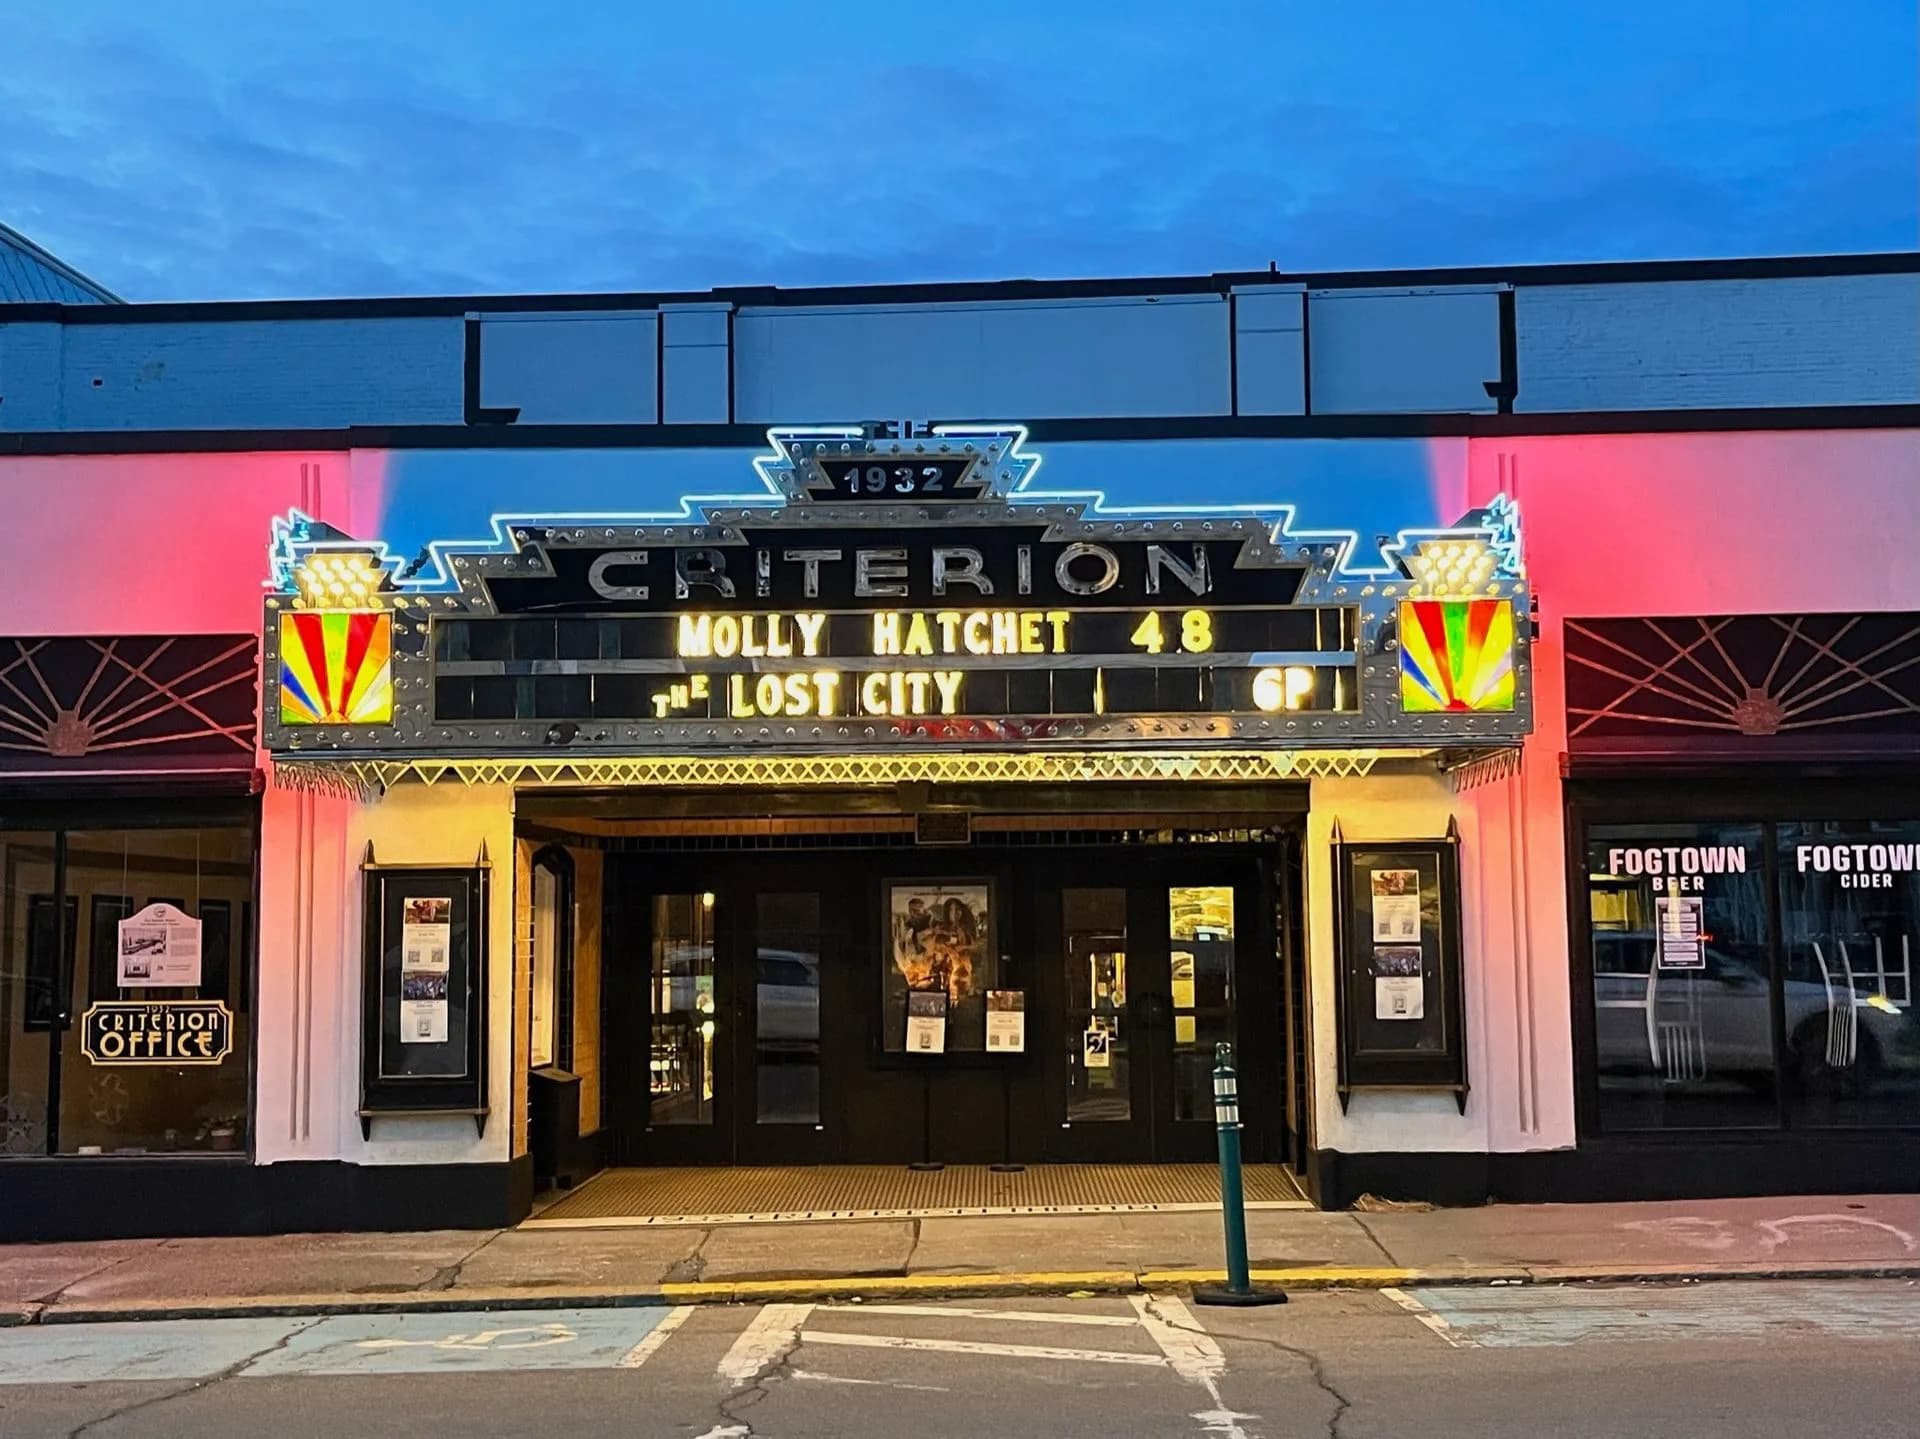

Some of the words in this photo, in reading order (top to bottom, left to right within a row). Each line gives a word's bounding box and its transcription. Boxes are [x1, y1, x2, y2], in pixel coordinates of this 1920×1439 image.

[843, 467, 943, 493] 1932
[588, 543, 1213, 599] CRITERION
[678, 613, 826, 657] MOLLY
[873, 611, 1071, 655] HATCHET
[652, 674, 710, 718] THE
[731, 672, 840, 717] LOST
[862, 670, 964, 715] CITY
[1252, 667, 1314, 711] 6P
[1609, 846, 1746, 875] FOGTOWN
[1797, 844, 1920, 872] FOGTOW
[1653, 876, 1705, 891] BEER
[1841, 873, 1893, 888] CIDER
[98, 1013, 218, 1030] CRITERION
[100, 1031, 212, 1057] OFFICE
